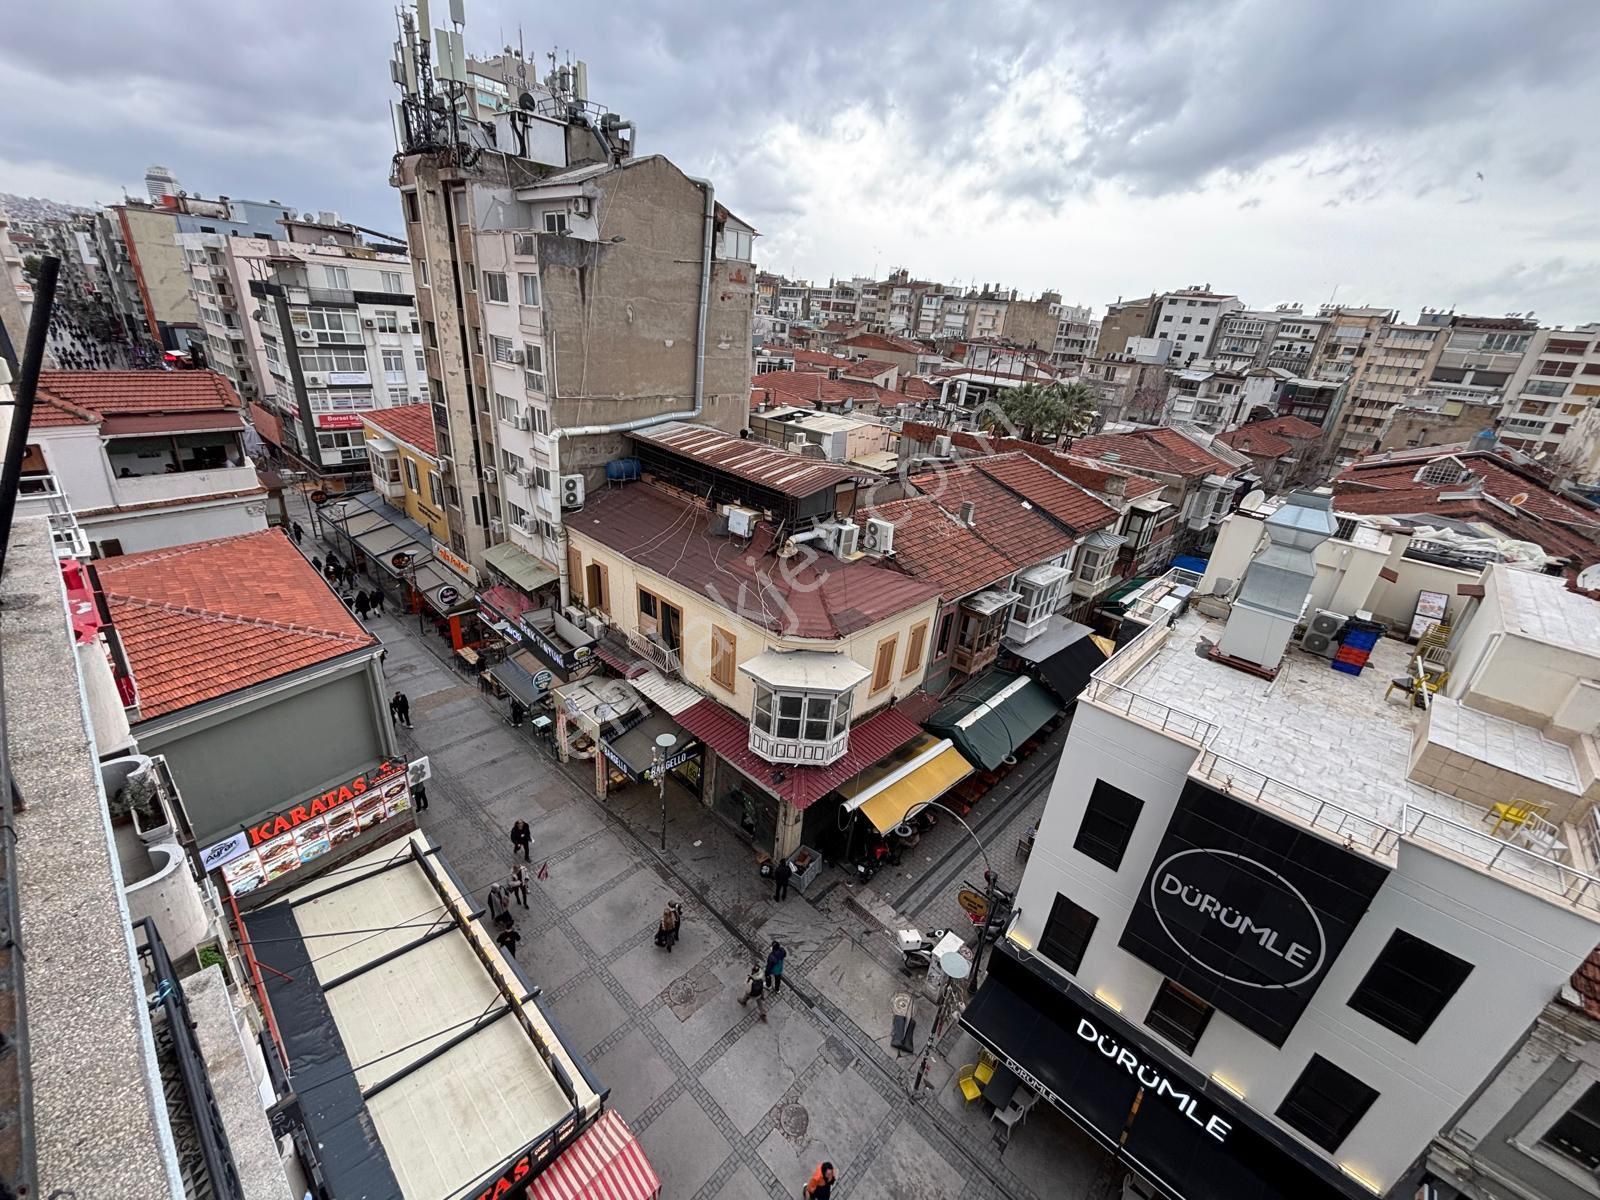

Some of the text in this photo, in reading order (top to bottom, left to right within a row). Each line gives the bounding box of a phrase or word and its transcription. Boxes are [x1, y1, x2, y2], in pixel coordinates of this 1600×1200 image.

[205, 839, 238, 865] Ayran
[1159, 872, 1314, 971] DÜRÜMLE
[1077, 1017, 1233, 1144] DÜRÜMLE
